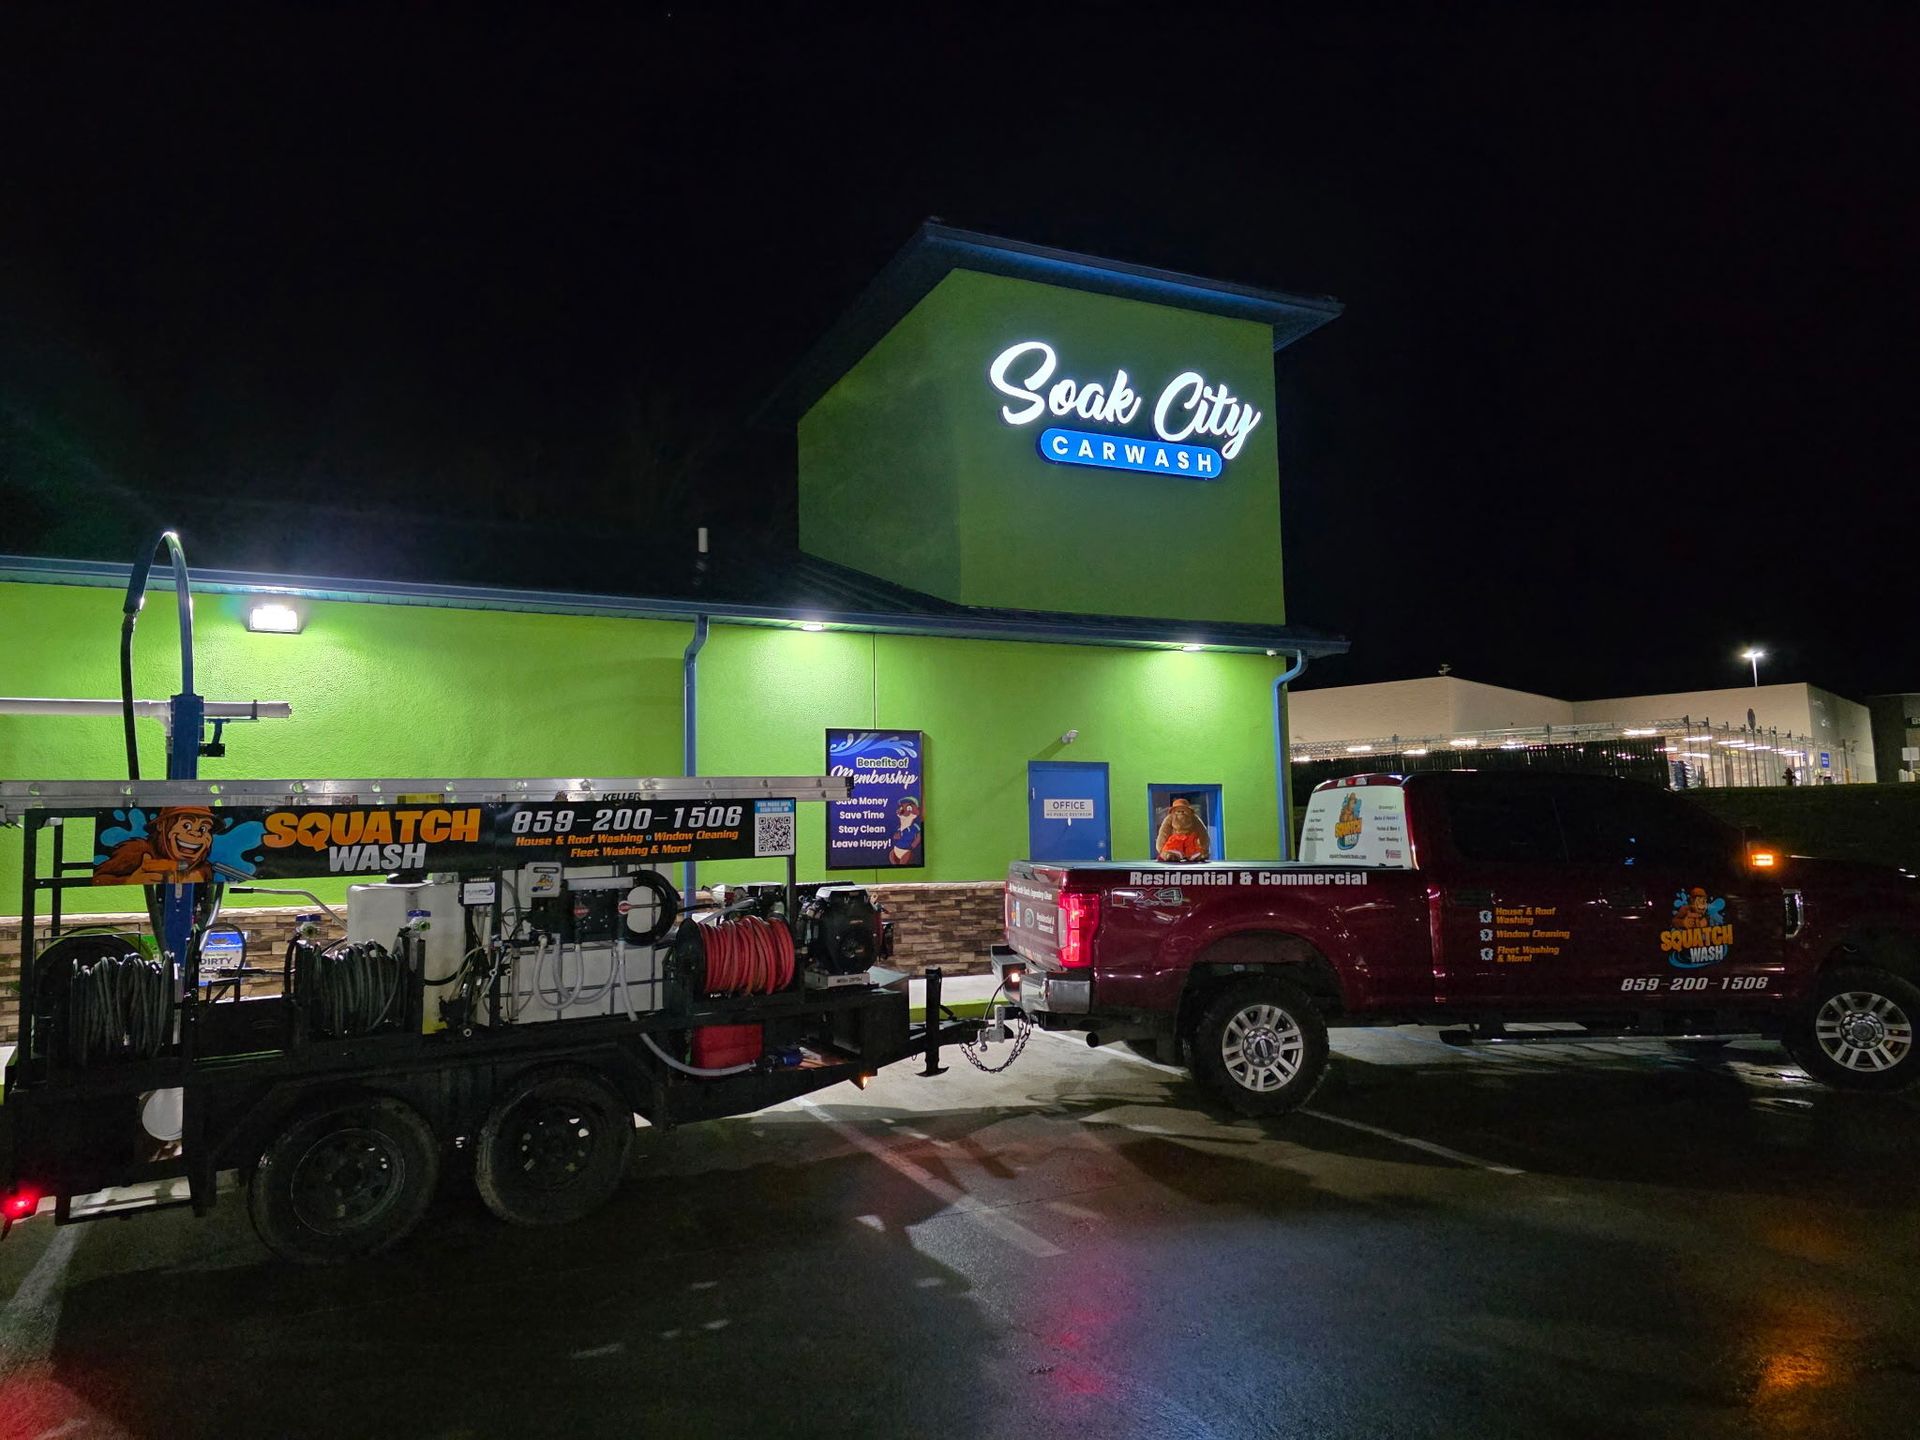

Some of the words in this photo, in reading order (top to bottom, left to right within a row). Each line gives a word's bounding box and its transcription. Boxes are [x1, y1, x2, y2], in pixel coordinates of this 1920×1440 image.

[990, 342, 1142, 425] Soak
[1154, 372, 1262, 460] City
[1052, 436, 1212, 472] CARWASH
[856, 757, 898, 768] Benefits
[898, 757, 908, 768] of
[602, 792, 641, 801] KELLER
[859, 797, 888, 807] Money
[1053, 801, 1085, 809] OFFICE
[512, 806, 742, 833] 859-200-1506
[840, 811, 861, 819] Save
[863, 810, 885, 819] Time
[262, 808, 482, 852] SQUATCH
[838, 826, 859, 835] Stay
[516, 836, 552, 846] House
[555, 836, 564, 845] &
[568, 834, 595, 844] Roof
[598, 833, 644, 844] Washing
[654, 832, 694, 841] Window
[696, 830, 739, 840] Cleaning
[832, 840, 858, 848] Leave
[860, 839, 892, 849] Happy!
[570, 848, 600, 857] Fleet
[602, 846, 648, 857] Washing
[650, 845, 659, 854] &
[662, 844, 692, 853] More!
[329, 843, 427, 872] WASH
[1129, 871, 1233, 886] Residential
[1239, 872, 1253, 886] &
[1258, 871, 1368, 886] Commercial
[1496, 907, 1524, 915] House
[1525, 907, 1532, 915] &
[1535, 907, 1556, 915] Roof
[1496, 916, 1534, 926] Washing
[1496, 930, 1530, 938] Window
[1532, 929, 1570, 940] Cleaning
[1660, 924, 1734, 952] SQUATCH
[1497, 946, 1520, 954] Fleet
[1522, 946, 1560, 955] Washing
[1690, 945, 1724, 963] WASH
[1506, 954, 1532, 962] More!
[1621, 976, 1769, 991] 859-200-1506
